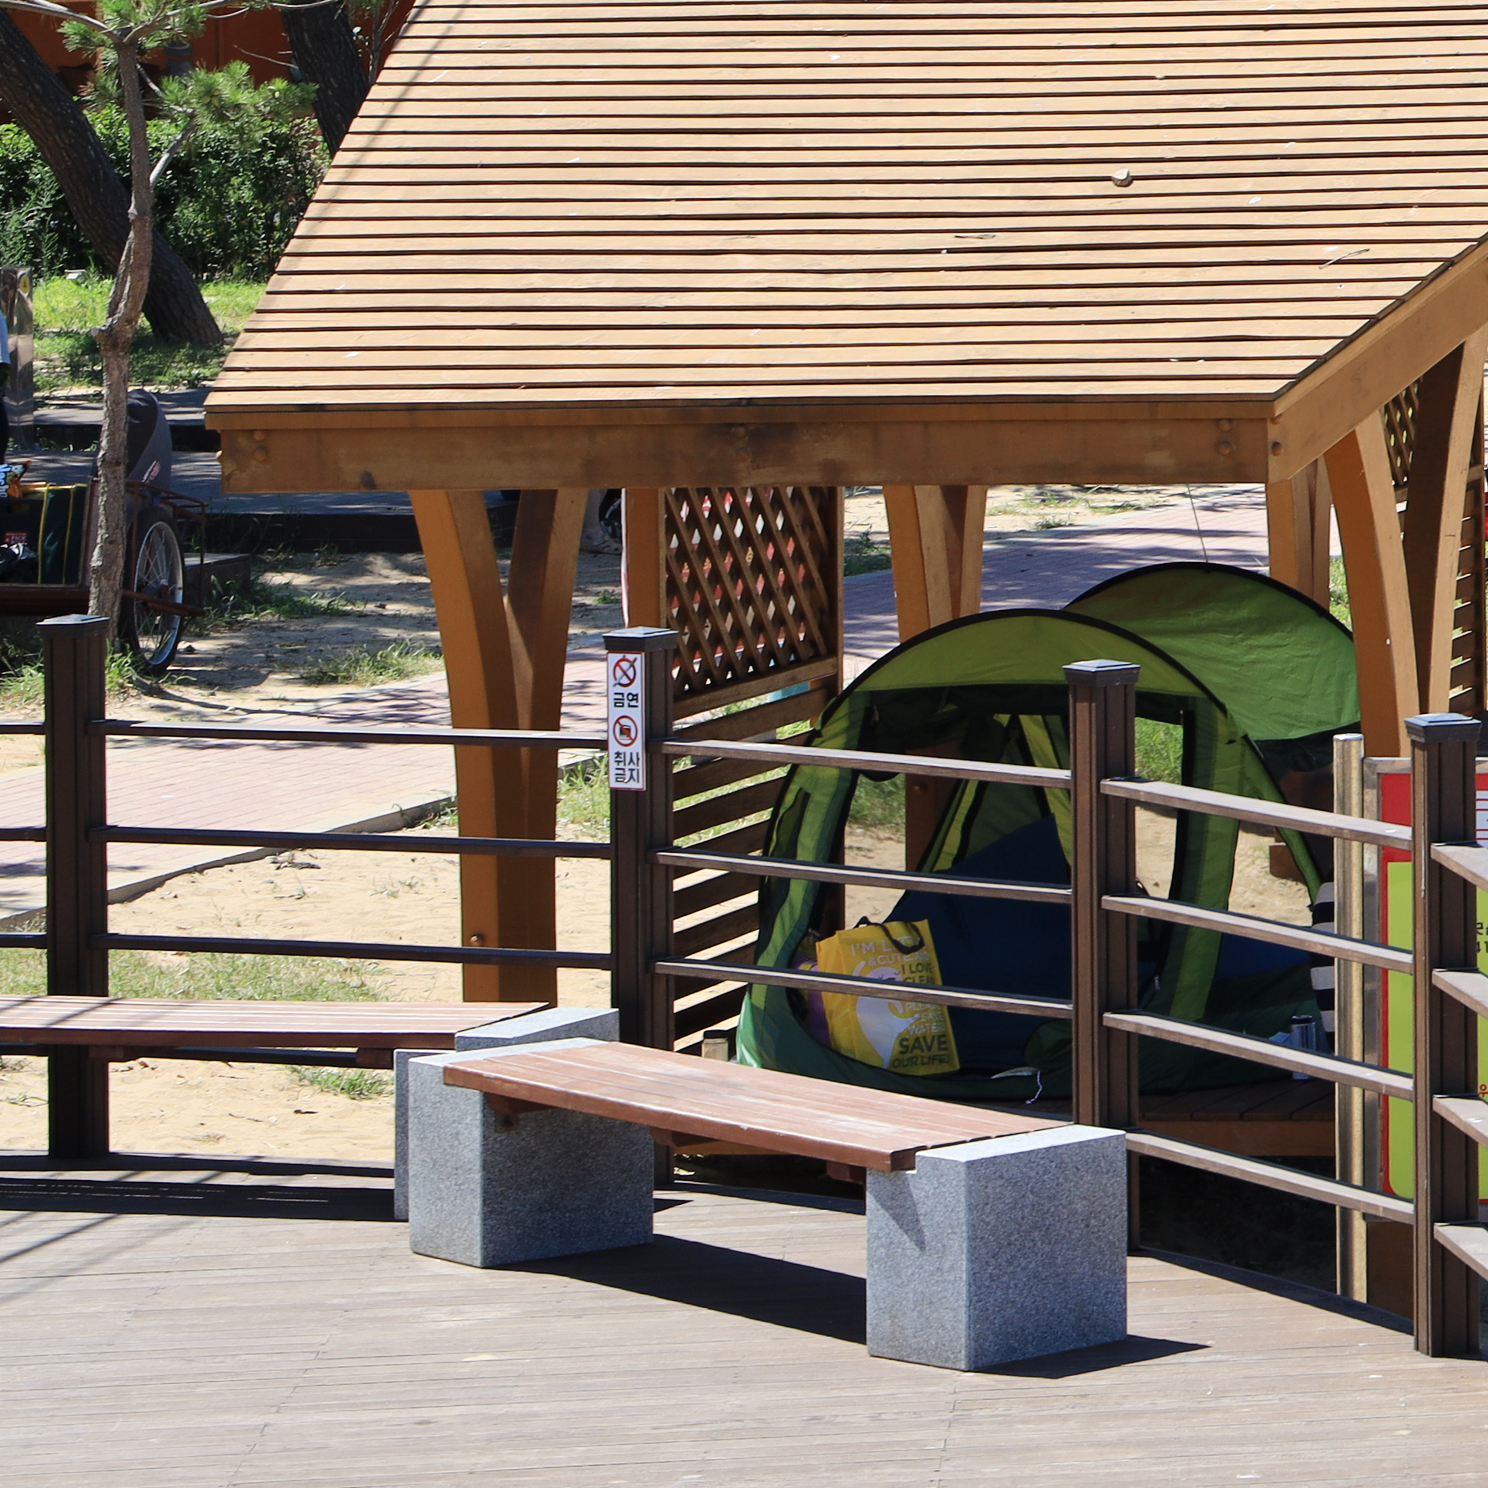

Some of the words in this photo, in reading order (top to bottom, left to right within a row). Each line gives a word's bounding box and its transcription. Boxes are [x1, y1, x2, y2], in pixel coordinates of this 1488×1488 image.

[613, 692, 639, 708] 금연
[614, 751, 640, 767] 취사
[614, 768, 640, 784] 금지
[898, 1034, 949, 1055] SAVE
[892, 1056, 920, 1069] OUR
